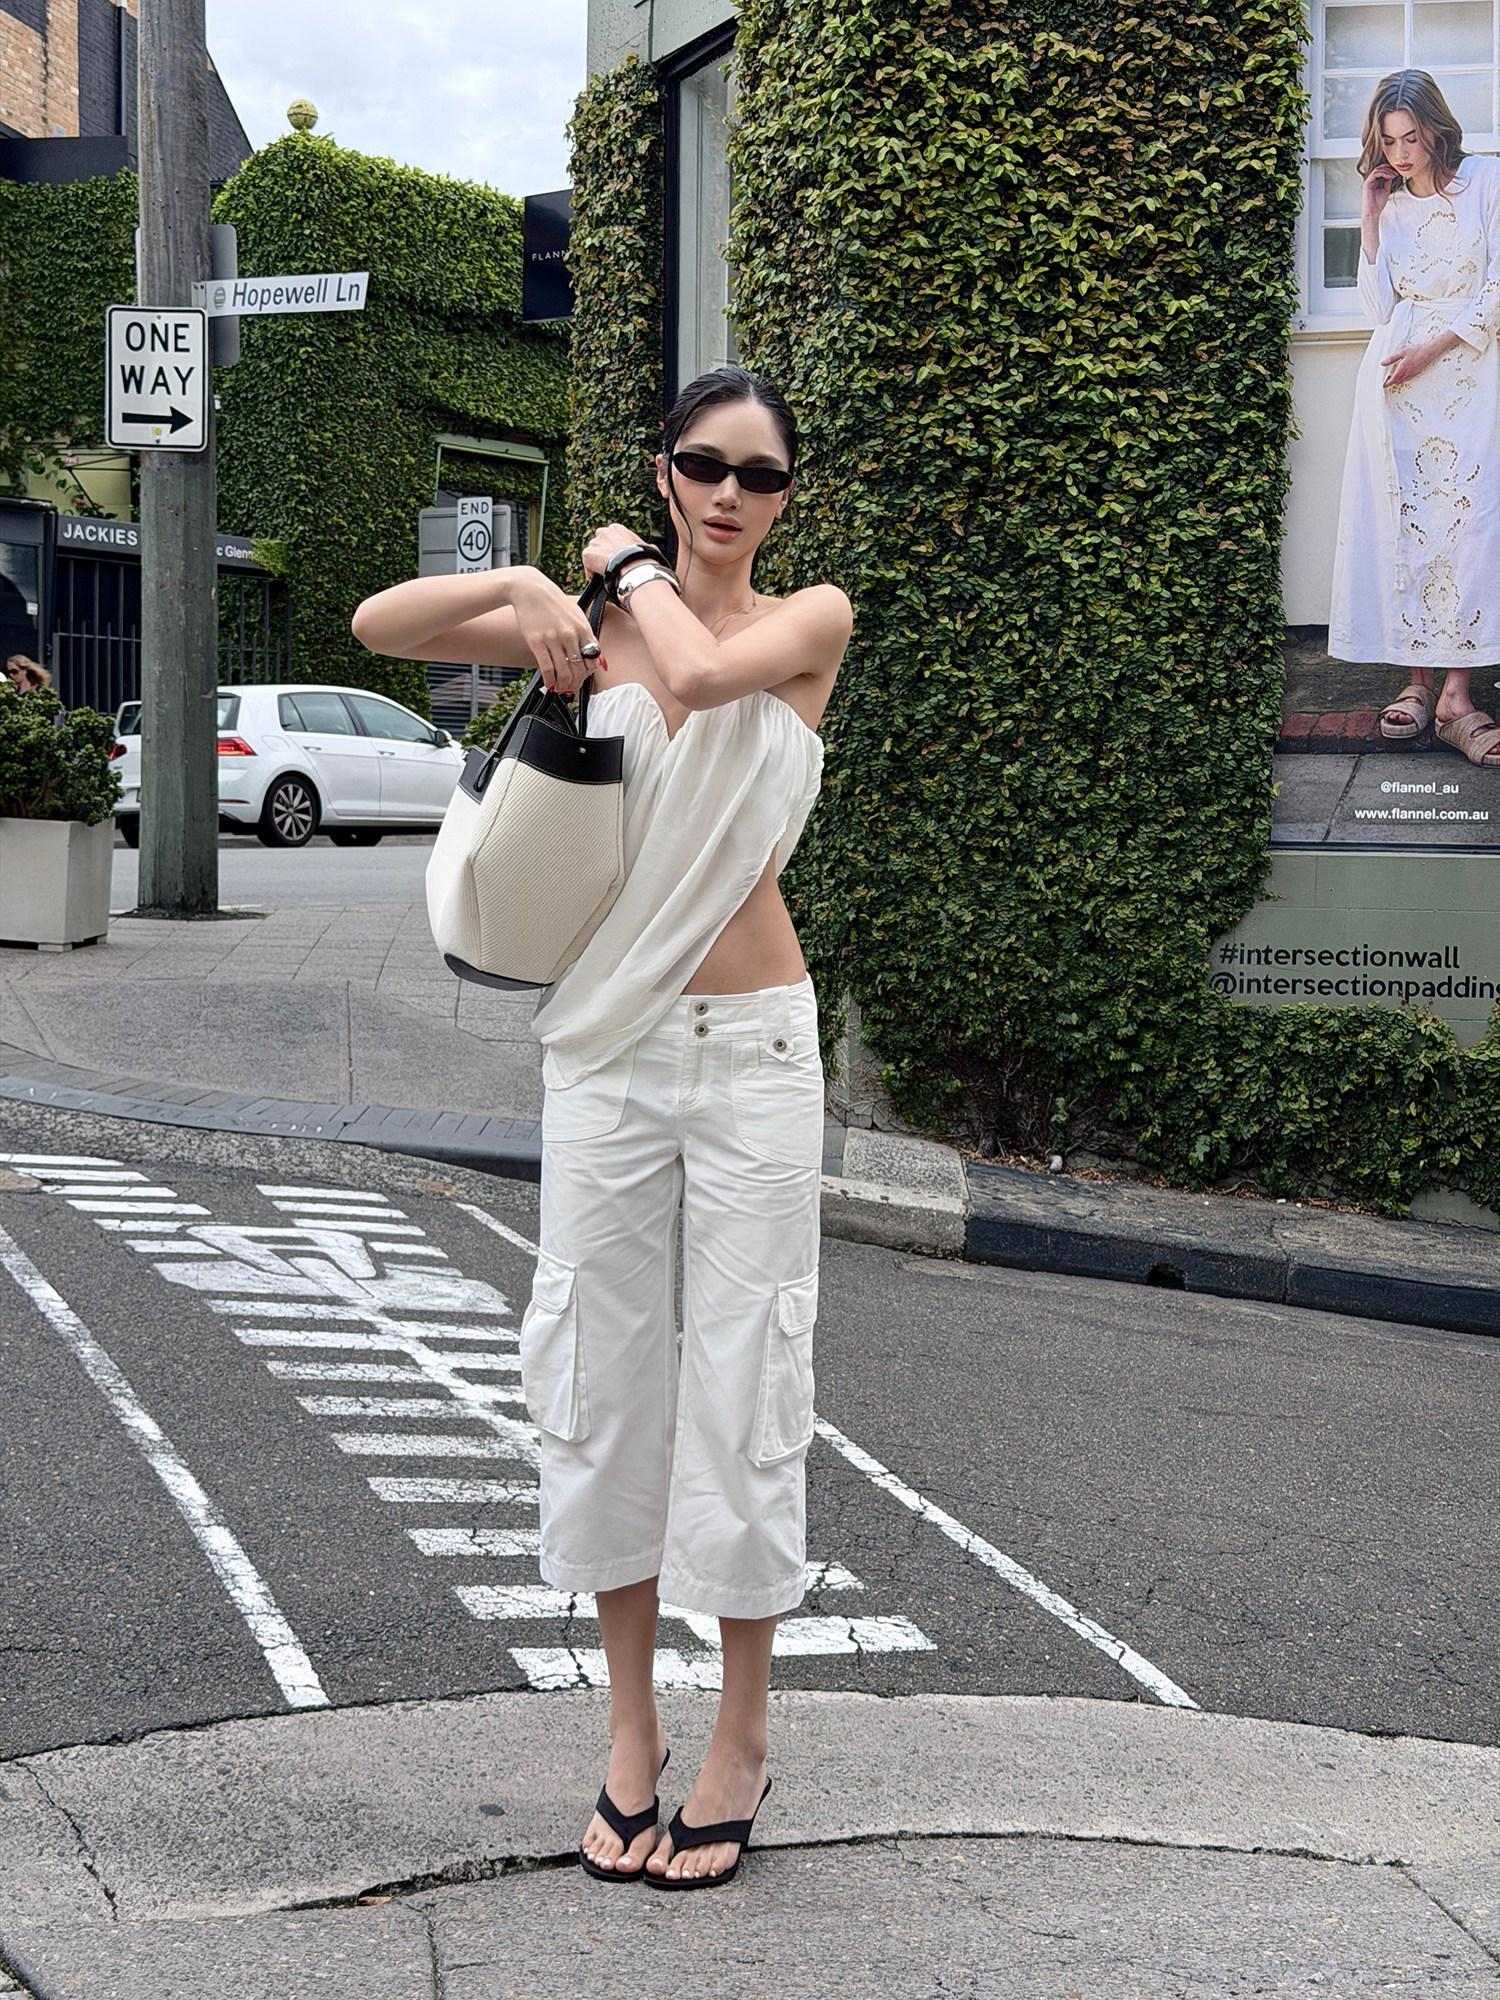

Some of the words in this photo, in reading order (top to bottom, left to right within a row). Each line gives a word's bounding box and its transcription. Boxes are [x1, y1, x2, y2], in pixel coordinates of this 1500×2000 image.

[232, 278, 328, 311] Hopewell
[336, 277, 360, 302] Ln
[125, 321, 190, 353] ONE
[120, 364, 195, 396] WAY
[461, 501, 490, 515] END
[63, 523, 138, 546] JACKIES
[463, 530, 487, 551] 40
[1380, 780, 1459, 796] @flannel_au
[1354, 807, 1489, 820] www.flannel.com.au
[1219, 943, 1460, 969] #intersectionwall
